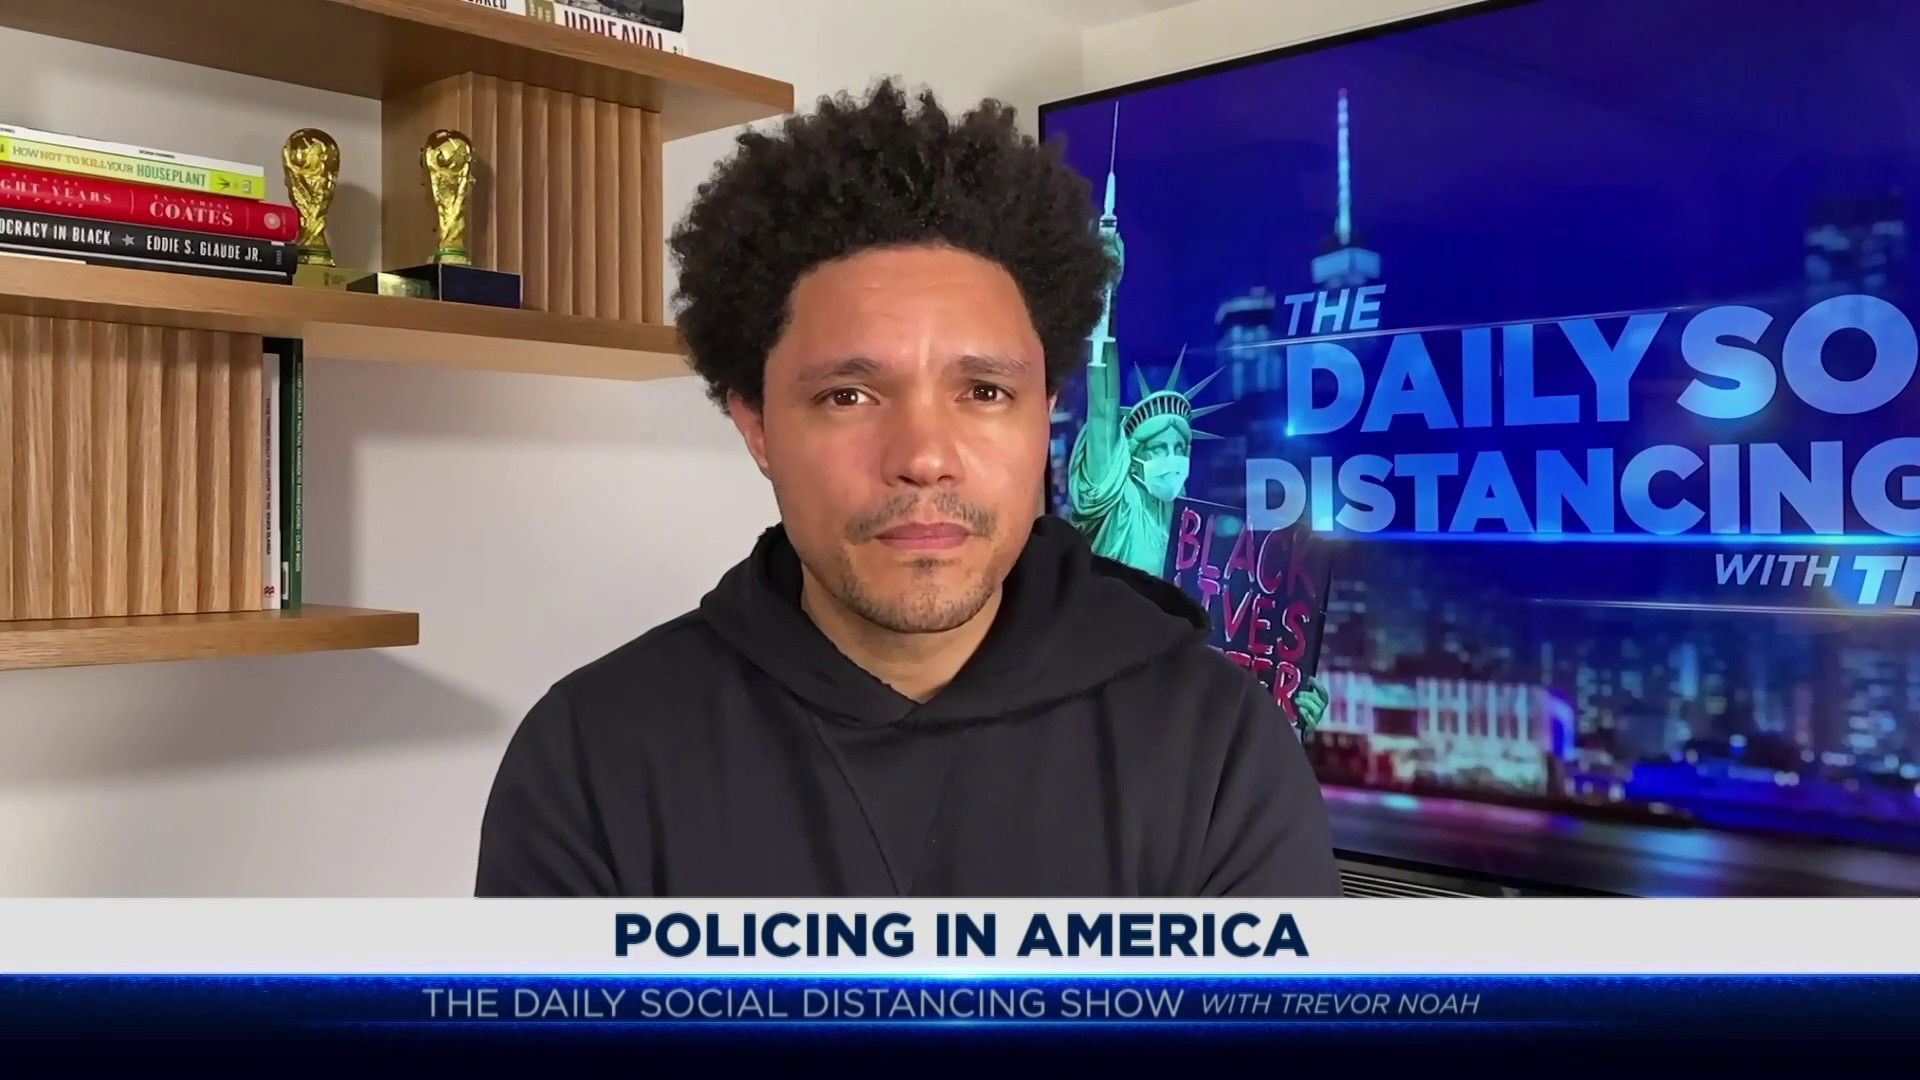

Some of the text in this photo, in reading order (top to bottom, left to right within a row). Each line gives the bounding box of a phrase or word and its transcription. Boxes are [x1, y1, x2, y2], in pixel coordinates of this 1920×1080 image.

[13, 145, 207, 187] HOW NOT TO KILL YOUR HOUSEPLANT
[51, 185, 112, 204] YEARS
[149, 201, 234, 228] COATES
[53, 224, 67, 241] IN
[72, 226, 111, 246] BLACK
[146, 234, 180, 254] EDDIE
[184, 239, 195, 255] S.
[200, 241, 241, 260] GLAUDE
[245, 247, 262, 263] JR.
[1283, 284, 1387, 336] THE
[1285, 311, 1669, 437] DAILY
[1245, 437, 1920, 538] DISTANCING
[1174, 505, 1317, 599] BLACK
[1714, 554, 1840, 588] WITH
